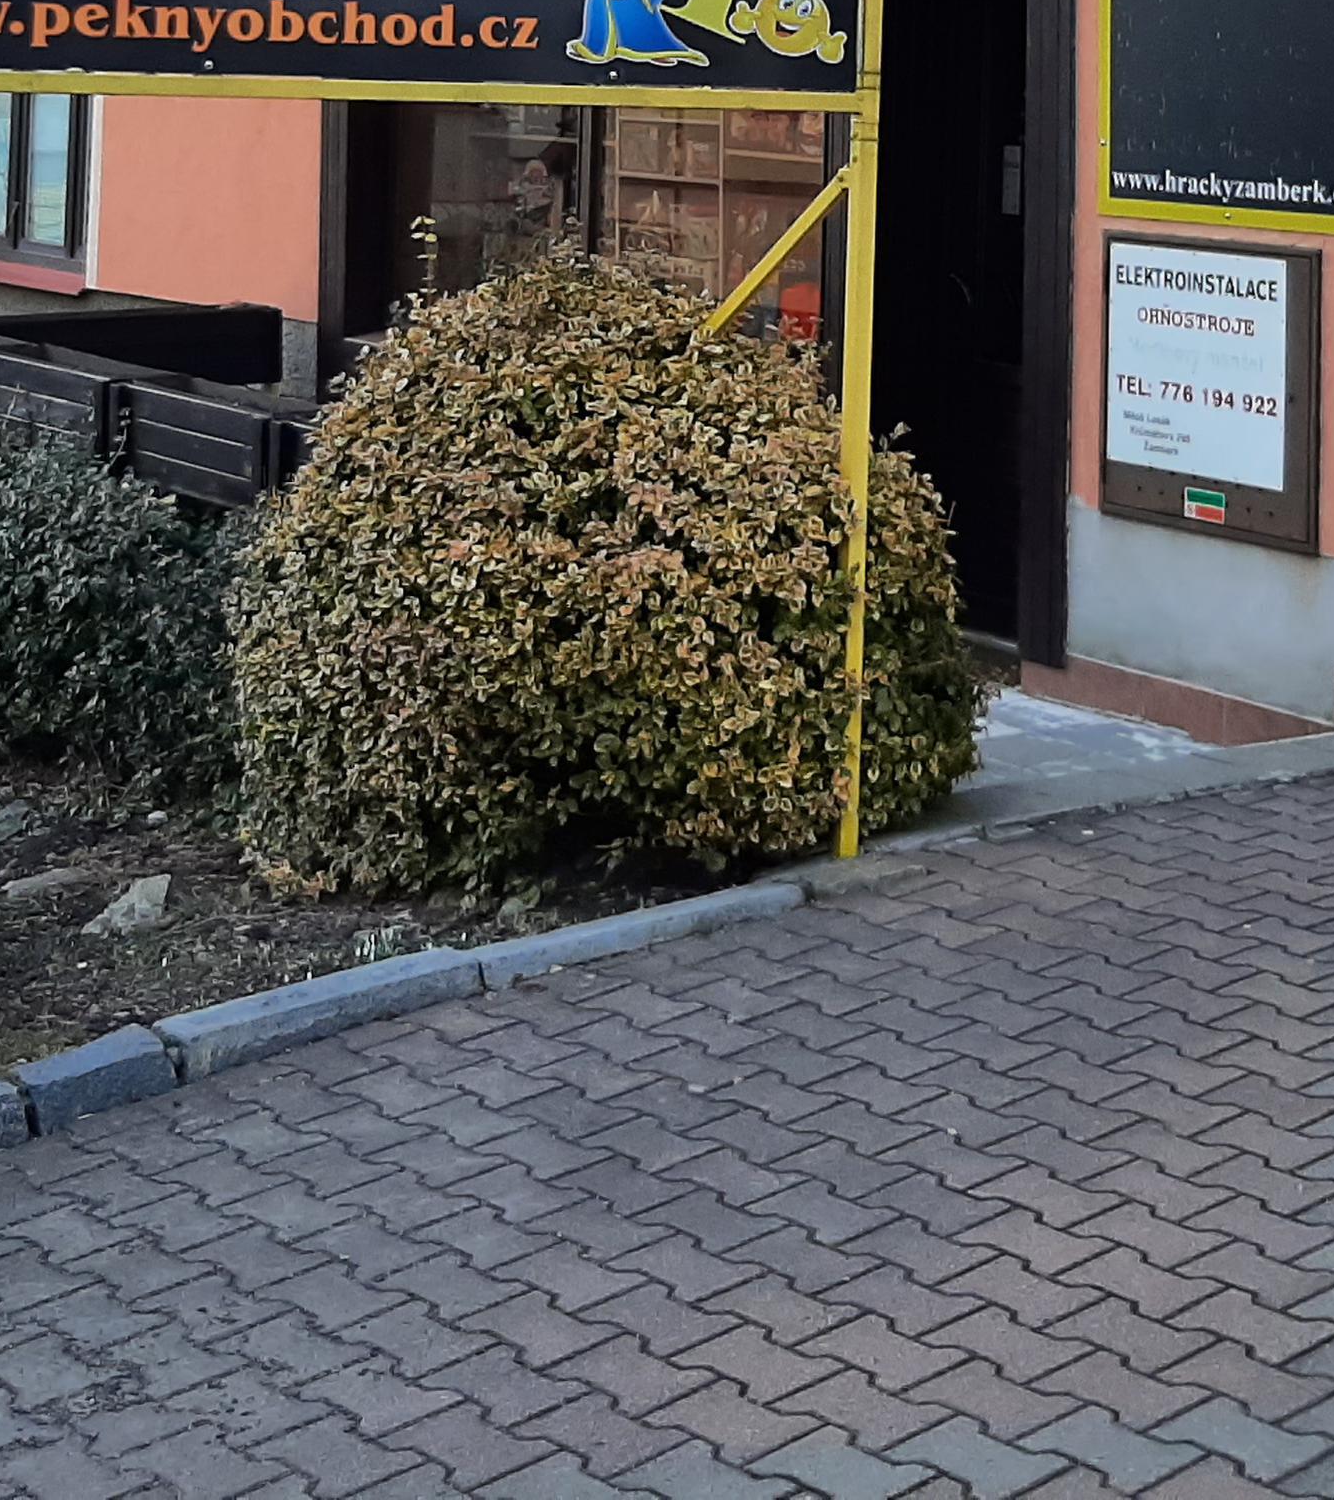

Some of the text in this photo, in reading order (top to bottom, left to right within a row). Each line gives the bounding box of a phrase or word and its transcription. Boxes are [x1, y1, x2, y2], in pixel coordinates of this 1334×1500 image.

[1116, 264, 1278, 302] ELEKTROINSTALACE
[1116, 374, 1278, 417] TEL: 776 194 922
